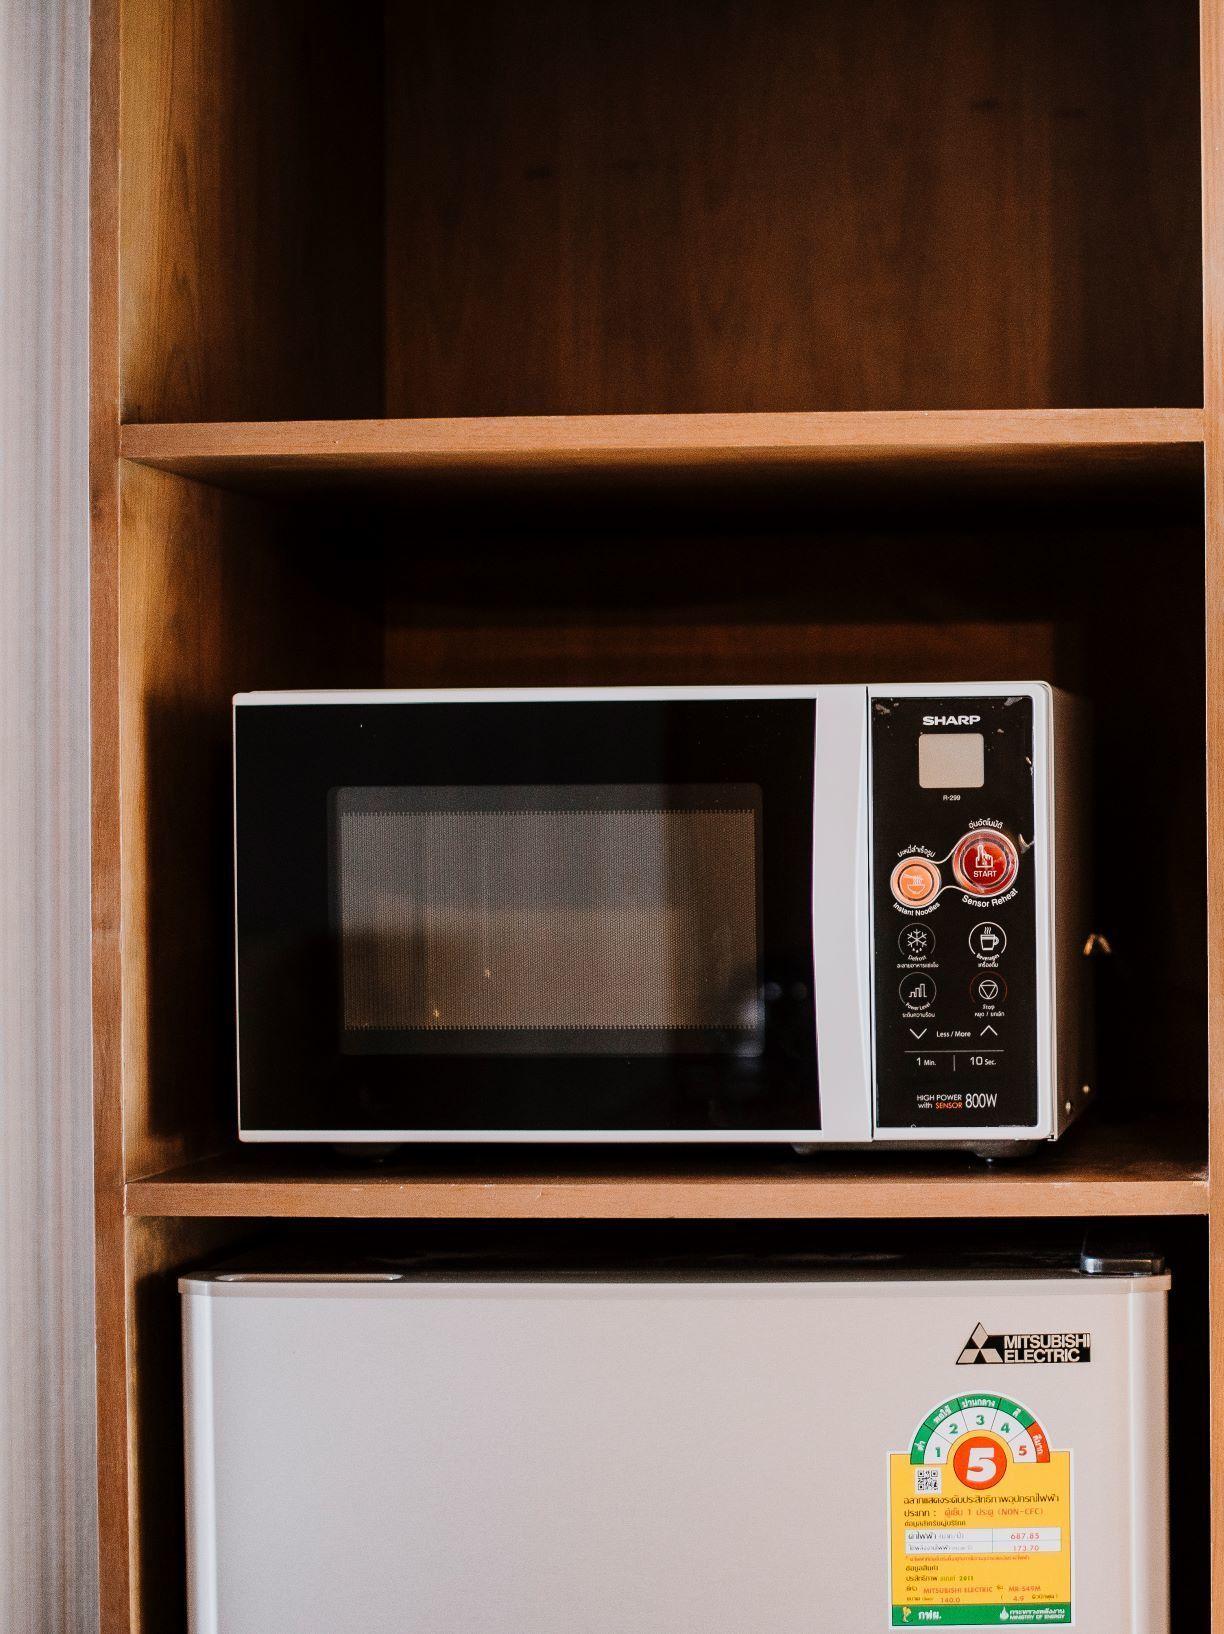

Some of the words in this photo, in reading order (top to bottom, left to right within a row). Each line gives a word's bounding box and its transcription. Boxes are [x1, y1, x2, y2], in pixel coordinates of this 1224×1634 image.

[922, 715, 981, 726] SHARP
[973, 870, 998, 878] START
[961, 894, 990, 908] Sensor
[991, 888, 1019, 907] Reheat
[892, 902, 914, 916] Instant
[914, 902, 940, 917] Noodles
[936, 1030, 950, 1038] Less
[954, 1030, 972, 1038] More
[916, 1057, 921, 1066] 1
[969, 1056, 984, 1066] 10
[984, 1058, 997, 1066] Sec.
[965, 1093, 998, 1108] 800W
[1003, 1333, 1091, 1349] MITSUBISHI
[1004, 1348, 1081, 1363] ELECTRIC
[975, 1415, 985, 1425] 3
[949, 1423, 959, 1434] 2
[1000, 1423, 1010, 1433] 4
[935, 1447, 941, 1458] 1
[1018, 1445, 1027, 1456] 5
[966, 1447, 997, 1482] 5
